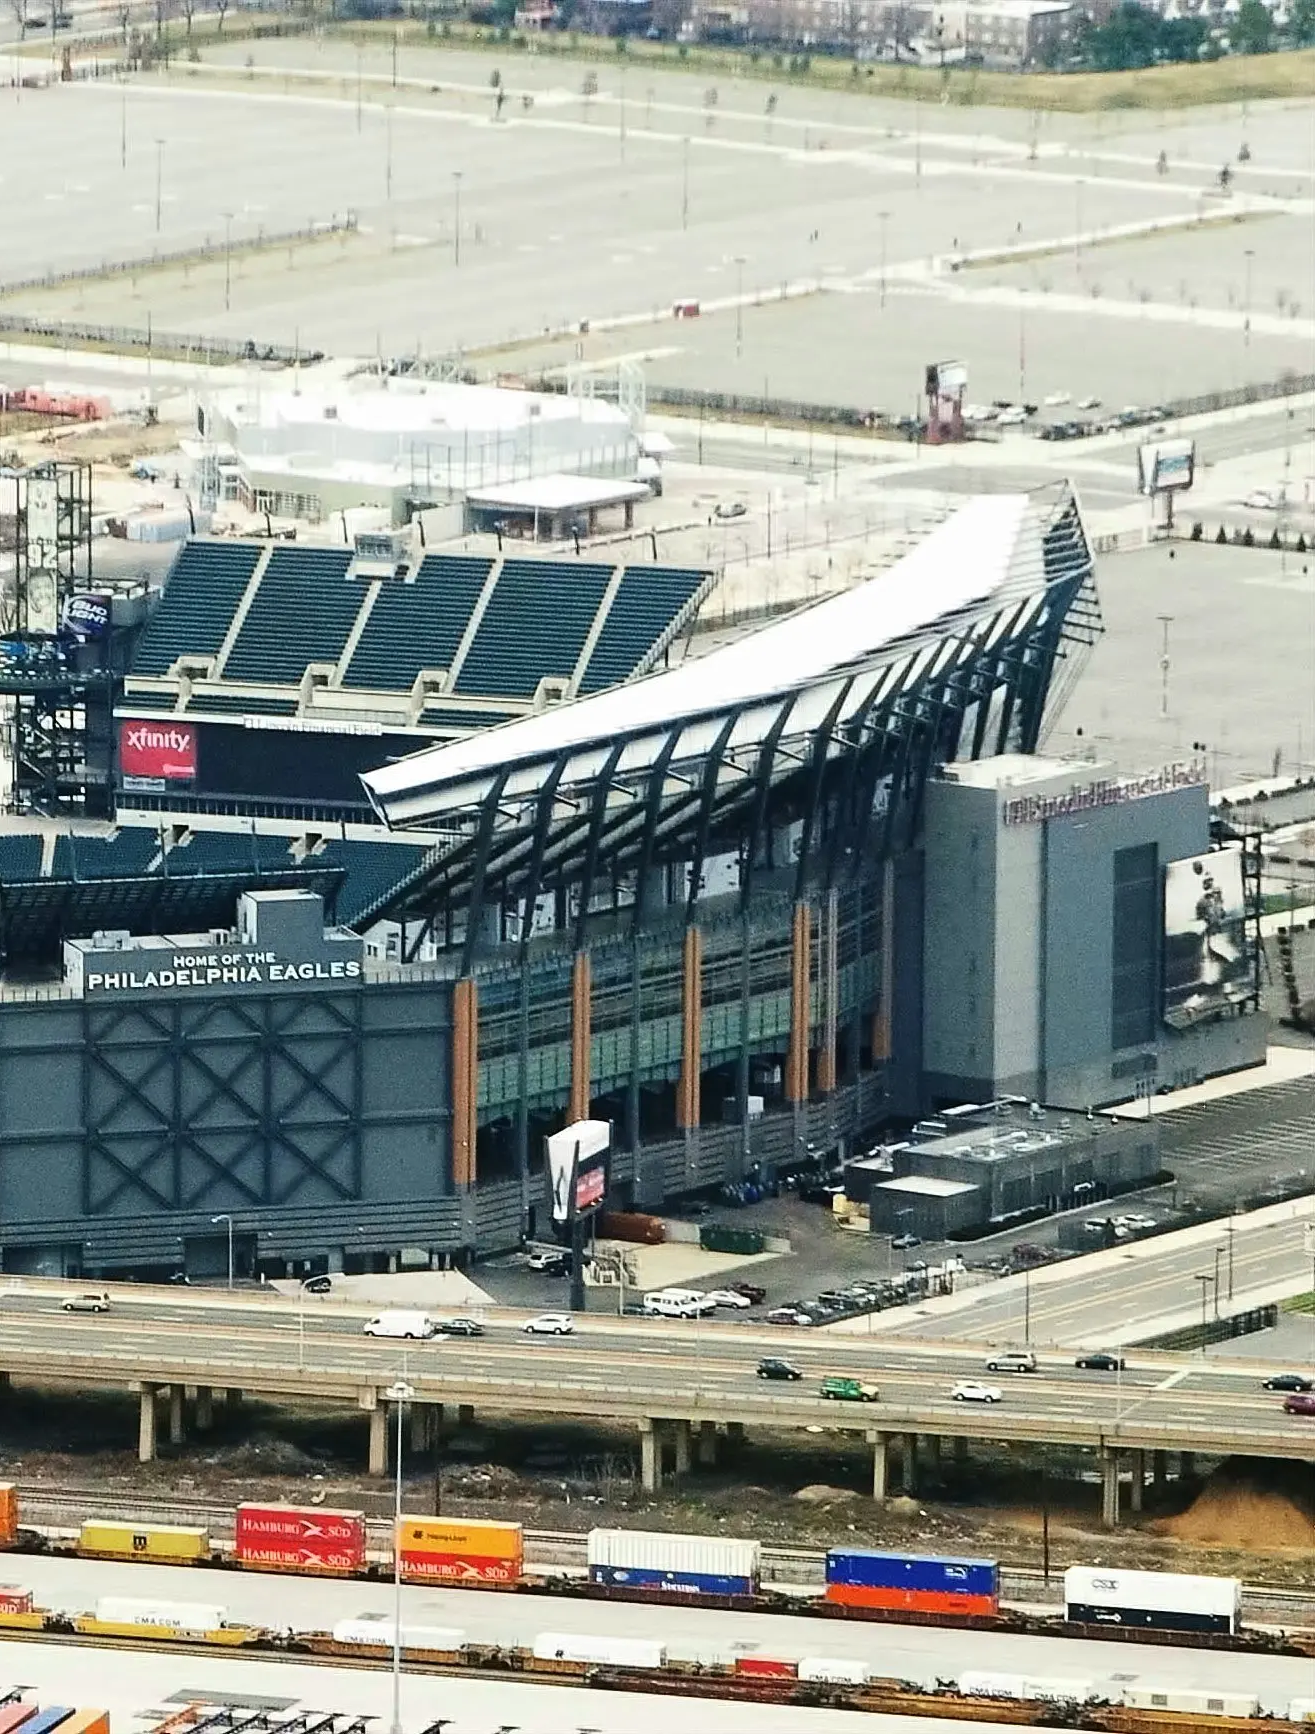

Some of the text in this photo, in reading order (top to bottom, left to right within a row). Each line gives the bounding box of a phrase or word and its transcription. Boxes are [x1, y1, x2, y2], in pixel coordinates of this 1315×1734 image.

[72, 600, 107, 616] BUD
[127, 727, 190, 753] xfinity
[173, 952, 276, 968] HOME OF THE
[88, 961, 361, 990] PHILADELPHIA EAGLES
[242, 1519, 351, 1537] HAMBURG SÜD
[242, 1548, 351, 1567] HAMBURG SÜD
[398, 1560, 509, 1579] HAMBURG SÜD
